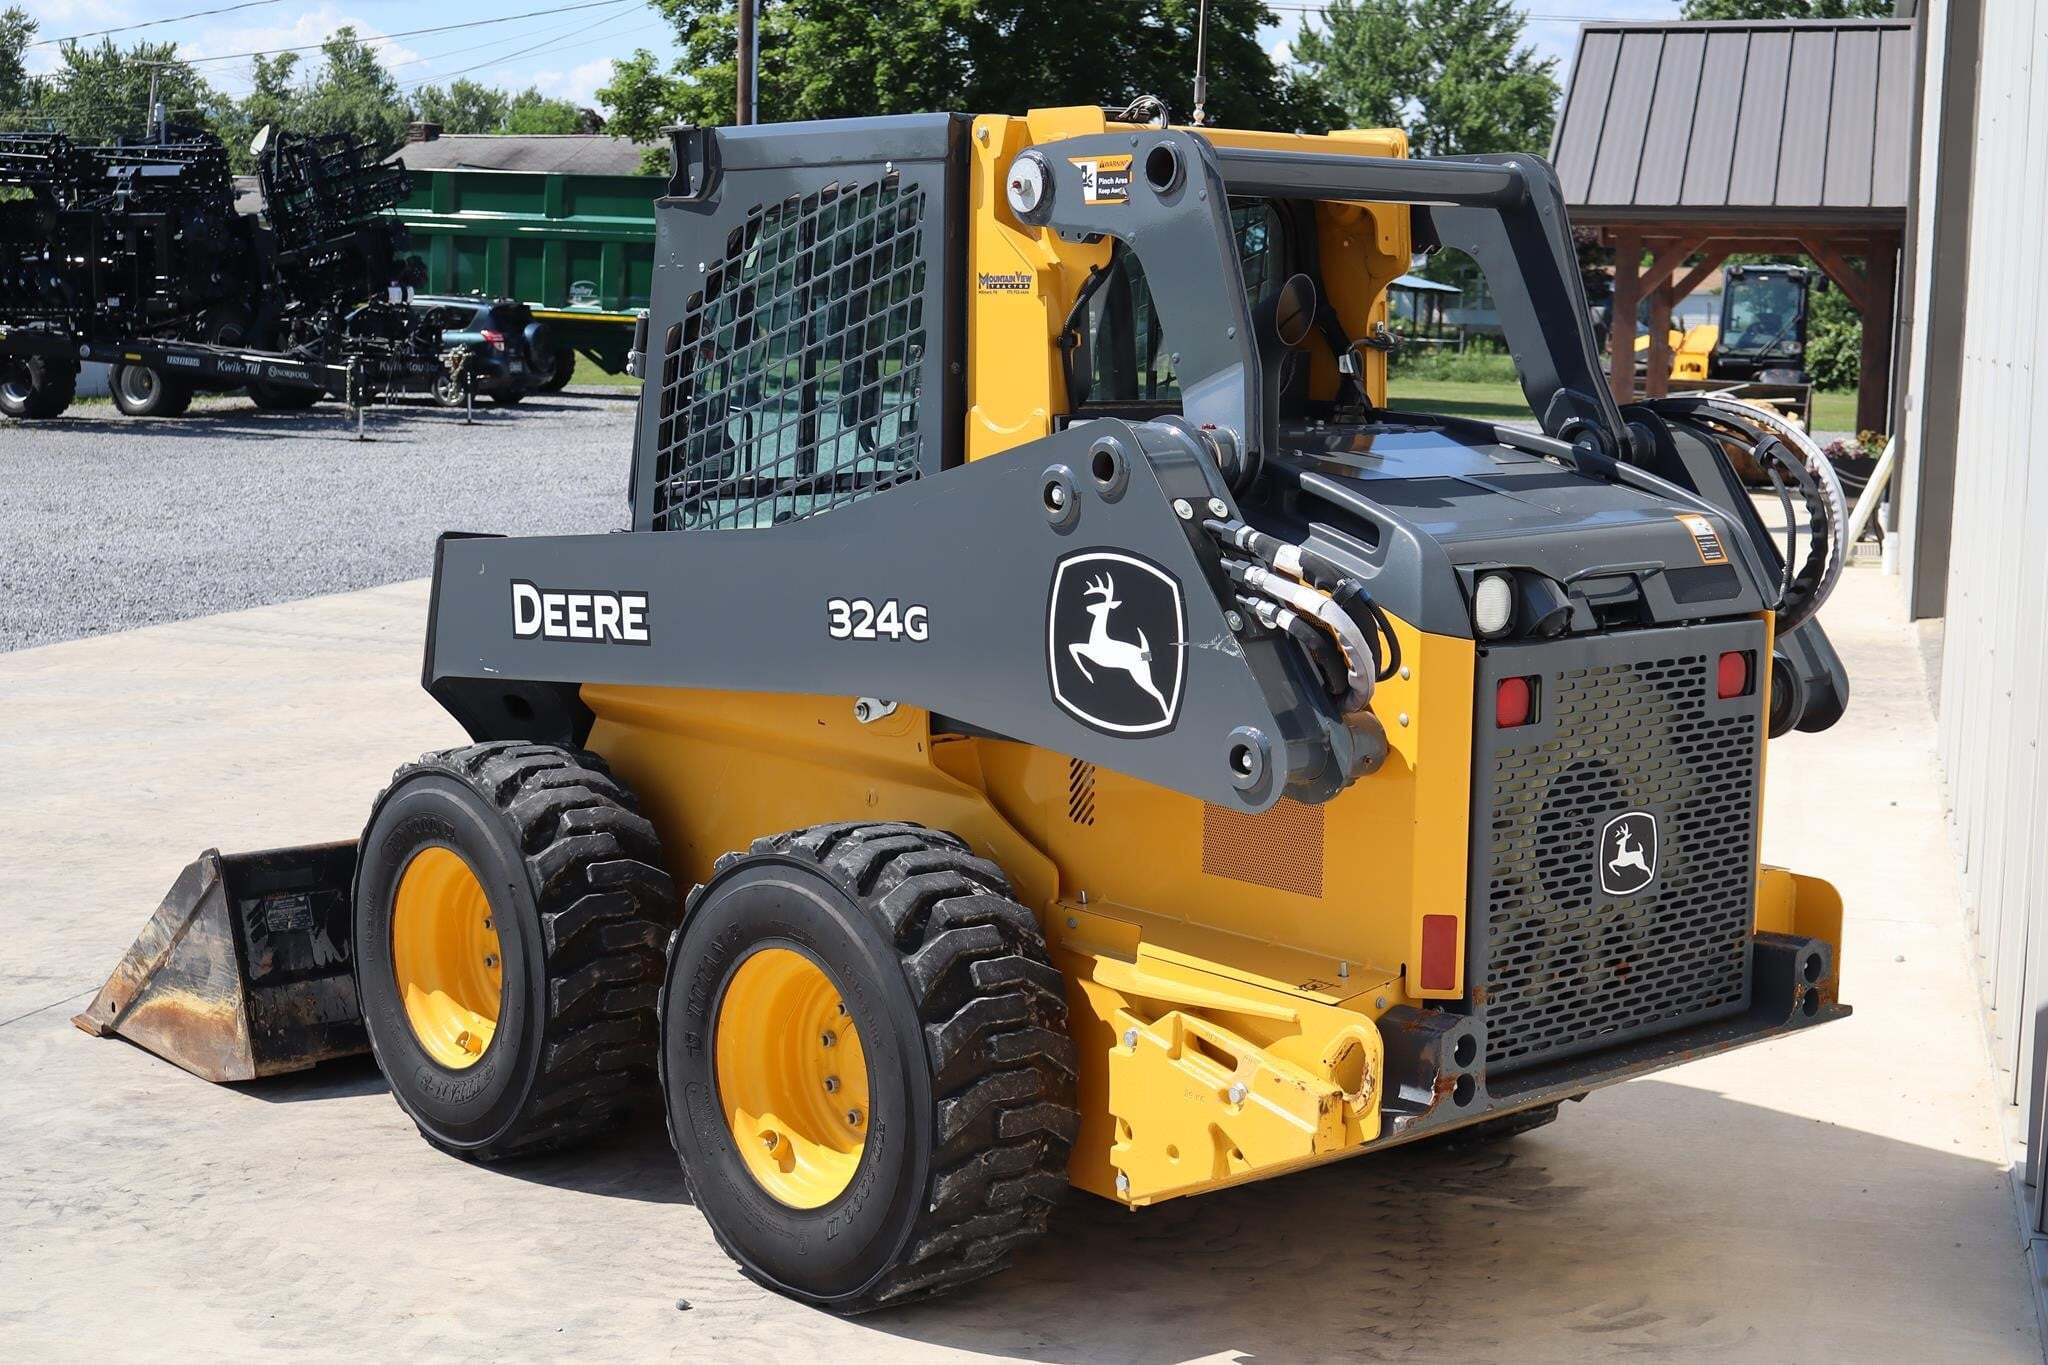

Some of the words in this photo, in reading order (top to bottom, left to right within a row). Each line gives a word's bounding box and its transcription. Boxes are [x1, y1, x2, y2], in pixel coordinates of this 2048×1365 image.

[1098, 177, 1115, 185] Pinch
[1115, 176, 1128, 184] Area
[978, 272, 1015, 289] MOUNTAIN
[1015, 271, 1032, 283] VIEW
[217, 359, 261, 375] Kwik-Till
[512, 582, 649, 643] DEERE
[827, 598, 929, 642] 324G
